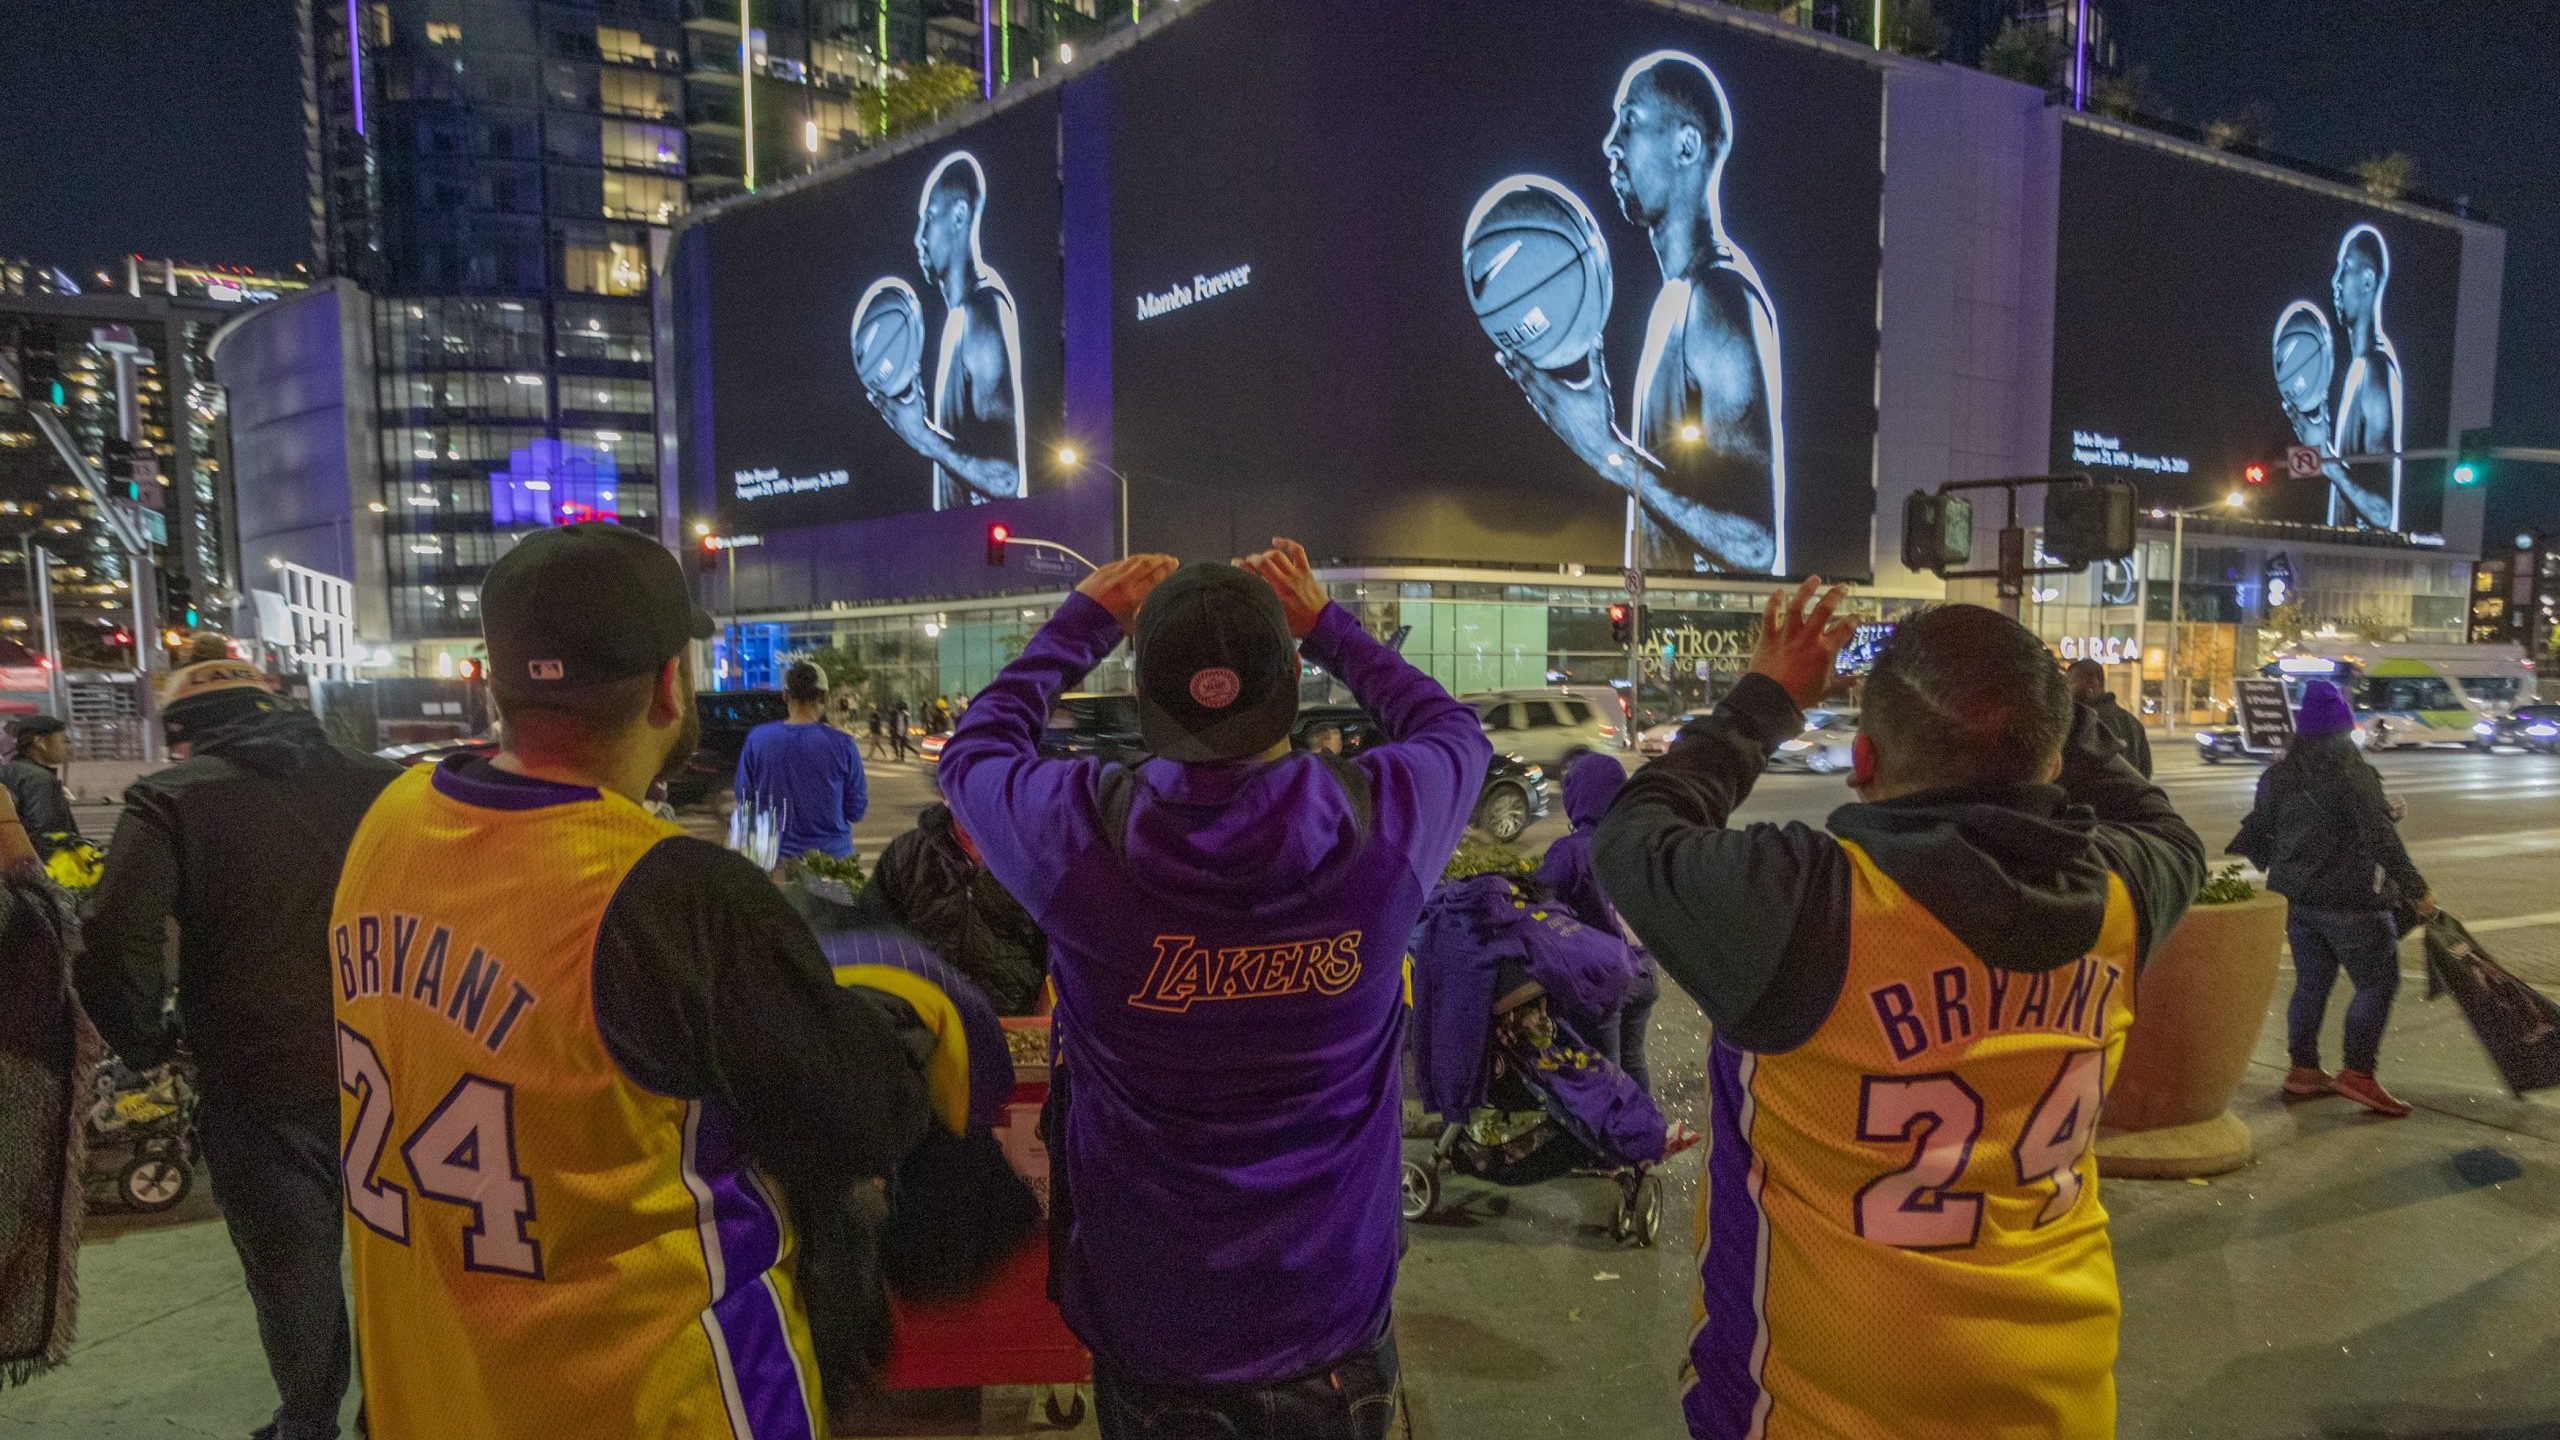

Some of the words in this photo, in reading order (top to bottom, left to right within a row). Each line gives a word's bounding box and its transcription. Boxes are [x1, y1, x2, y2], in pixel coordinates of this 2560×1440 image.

[1136, 283, 1193, 320] Mamba
[1193, 264, 1251, 302] Forever
[333, 911, 540, 1054] BRYANT
[1127, 929, 1362, 1014] LAKERS
[1868, 954, 2120, 1062] BRYANT
[337, 1018, 546, 1283] 24
[1853, 1048, 2106, 1252] 24
